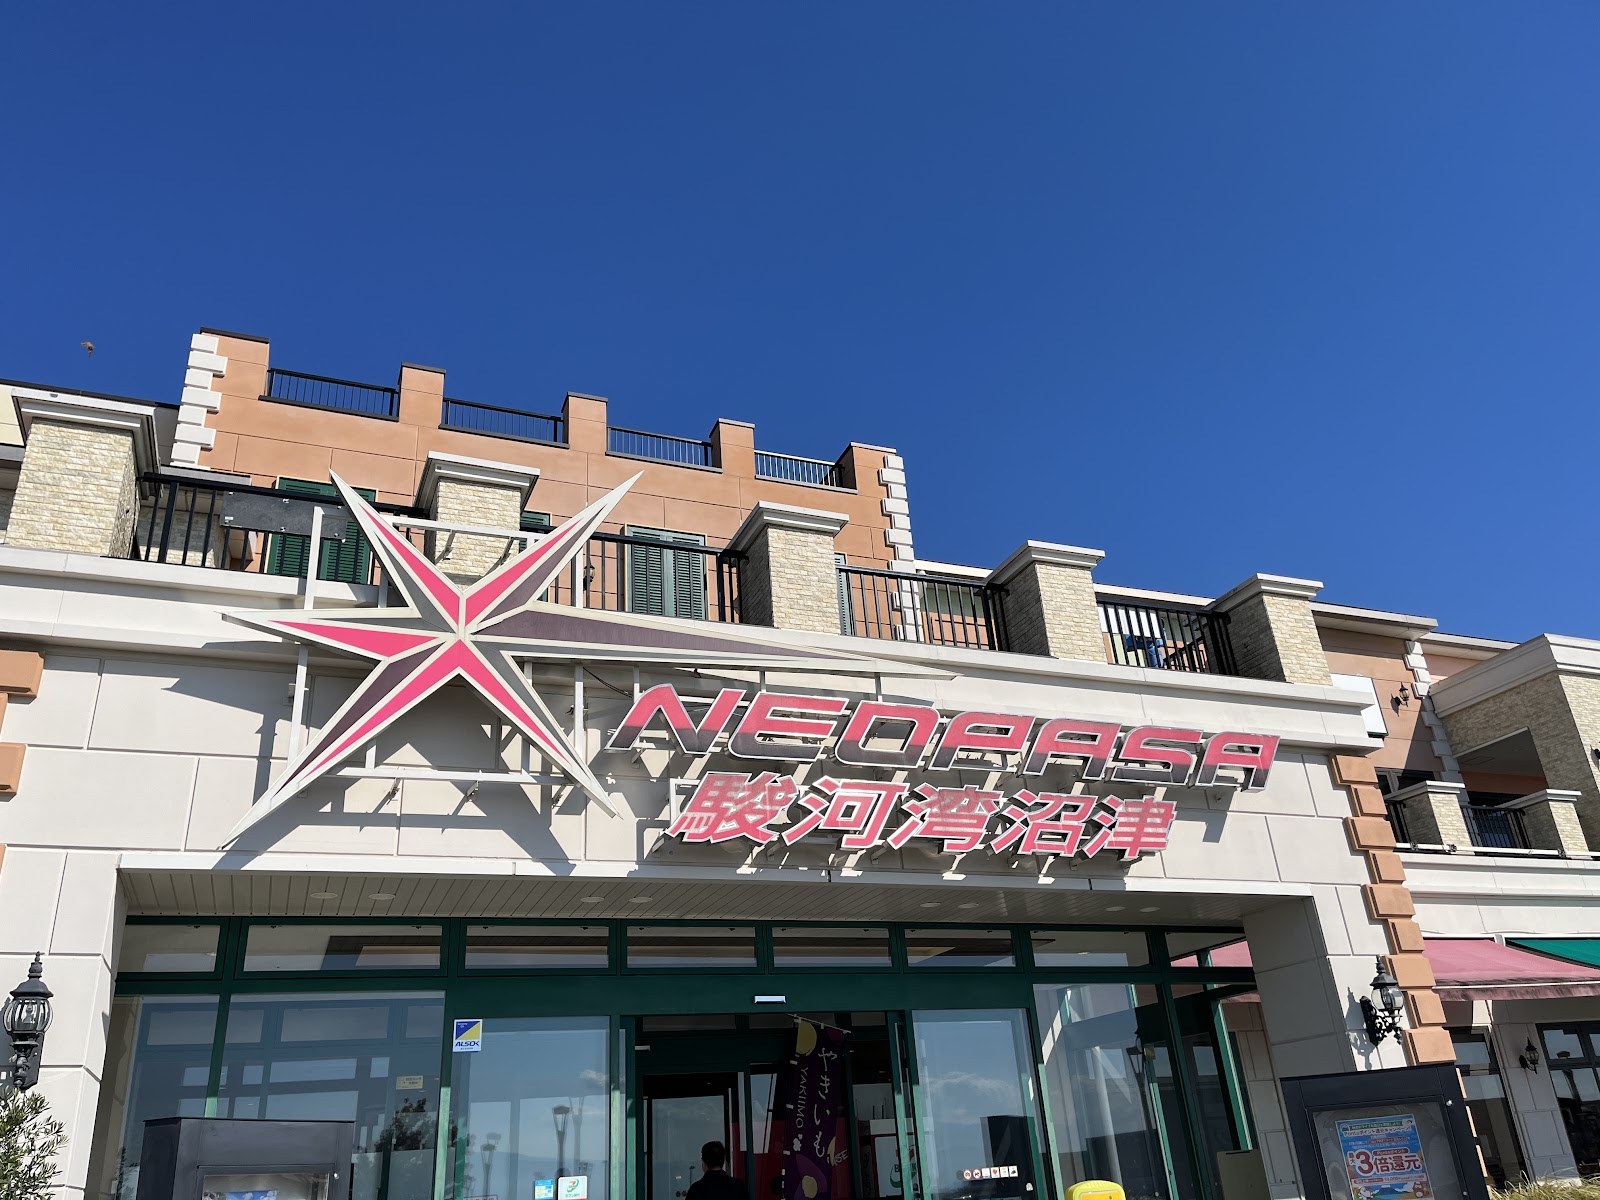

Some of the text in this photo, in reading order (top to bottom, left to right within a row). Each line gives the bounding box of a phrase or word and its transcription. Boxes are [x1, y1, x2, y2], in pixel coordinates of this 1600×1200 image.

[605, 683, 1282, 791] NEOPASA
[670, 771, 1178, 859] 駿河湾沼津
[795, 1066, 809, 1129] YAKIIMO
